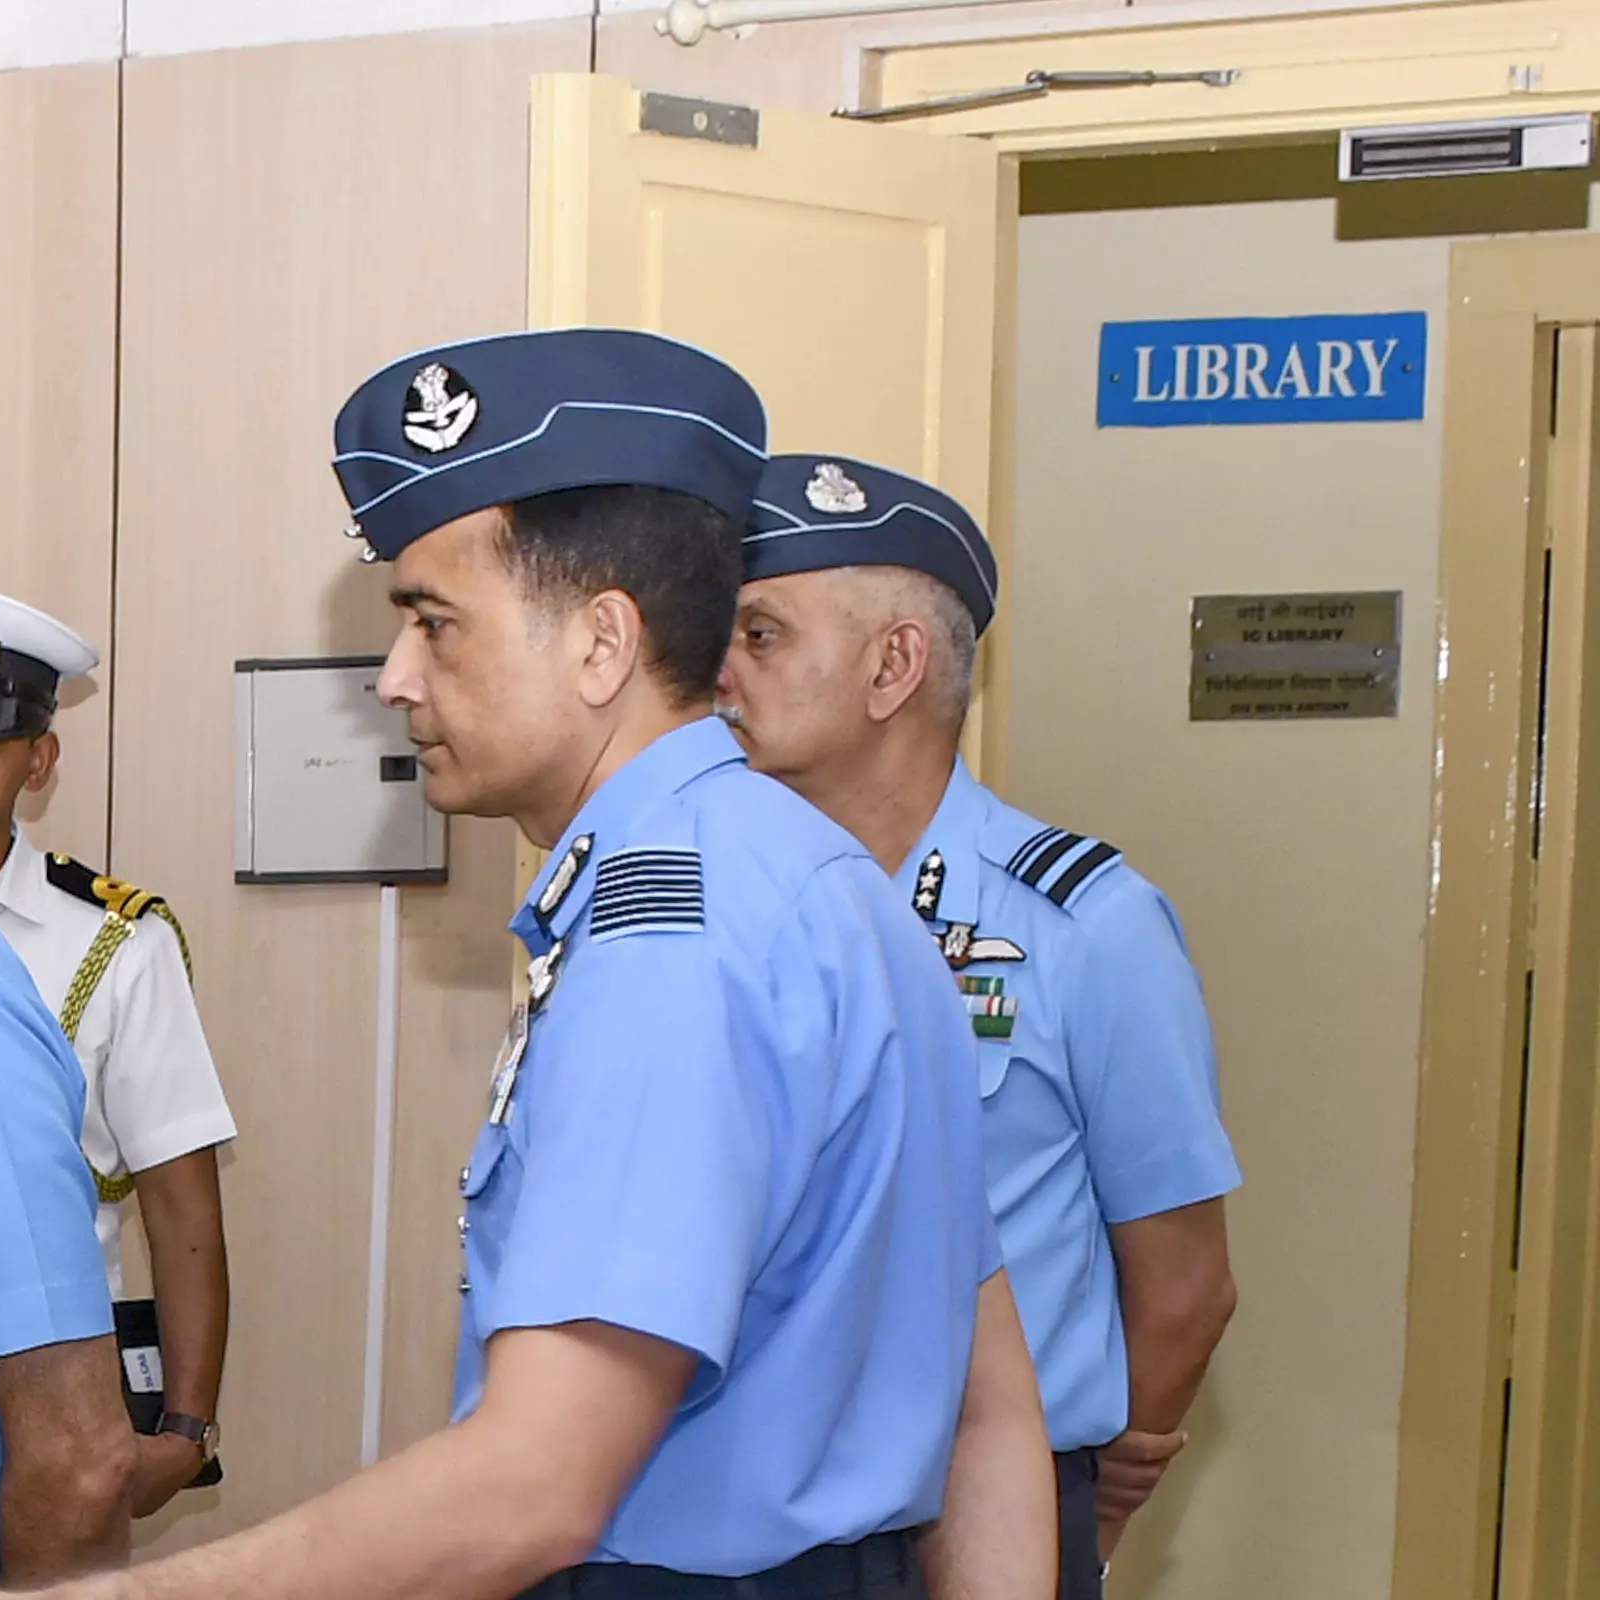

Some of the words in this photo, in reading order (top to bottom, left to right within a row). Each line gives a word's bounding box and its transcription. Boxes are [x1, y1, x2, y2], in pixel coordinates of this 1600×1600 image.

[1133, 338, 1399, 402] LIBRARY
[1242, 630, 1261, 643] IC
[1267, 628, 1345, 643] LIBRARY
